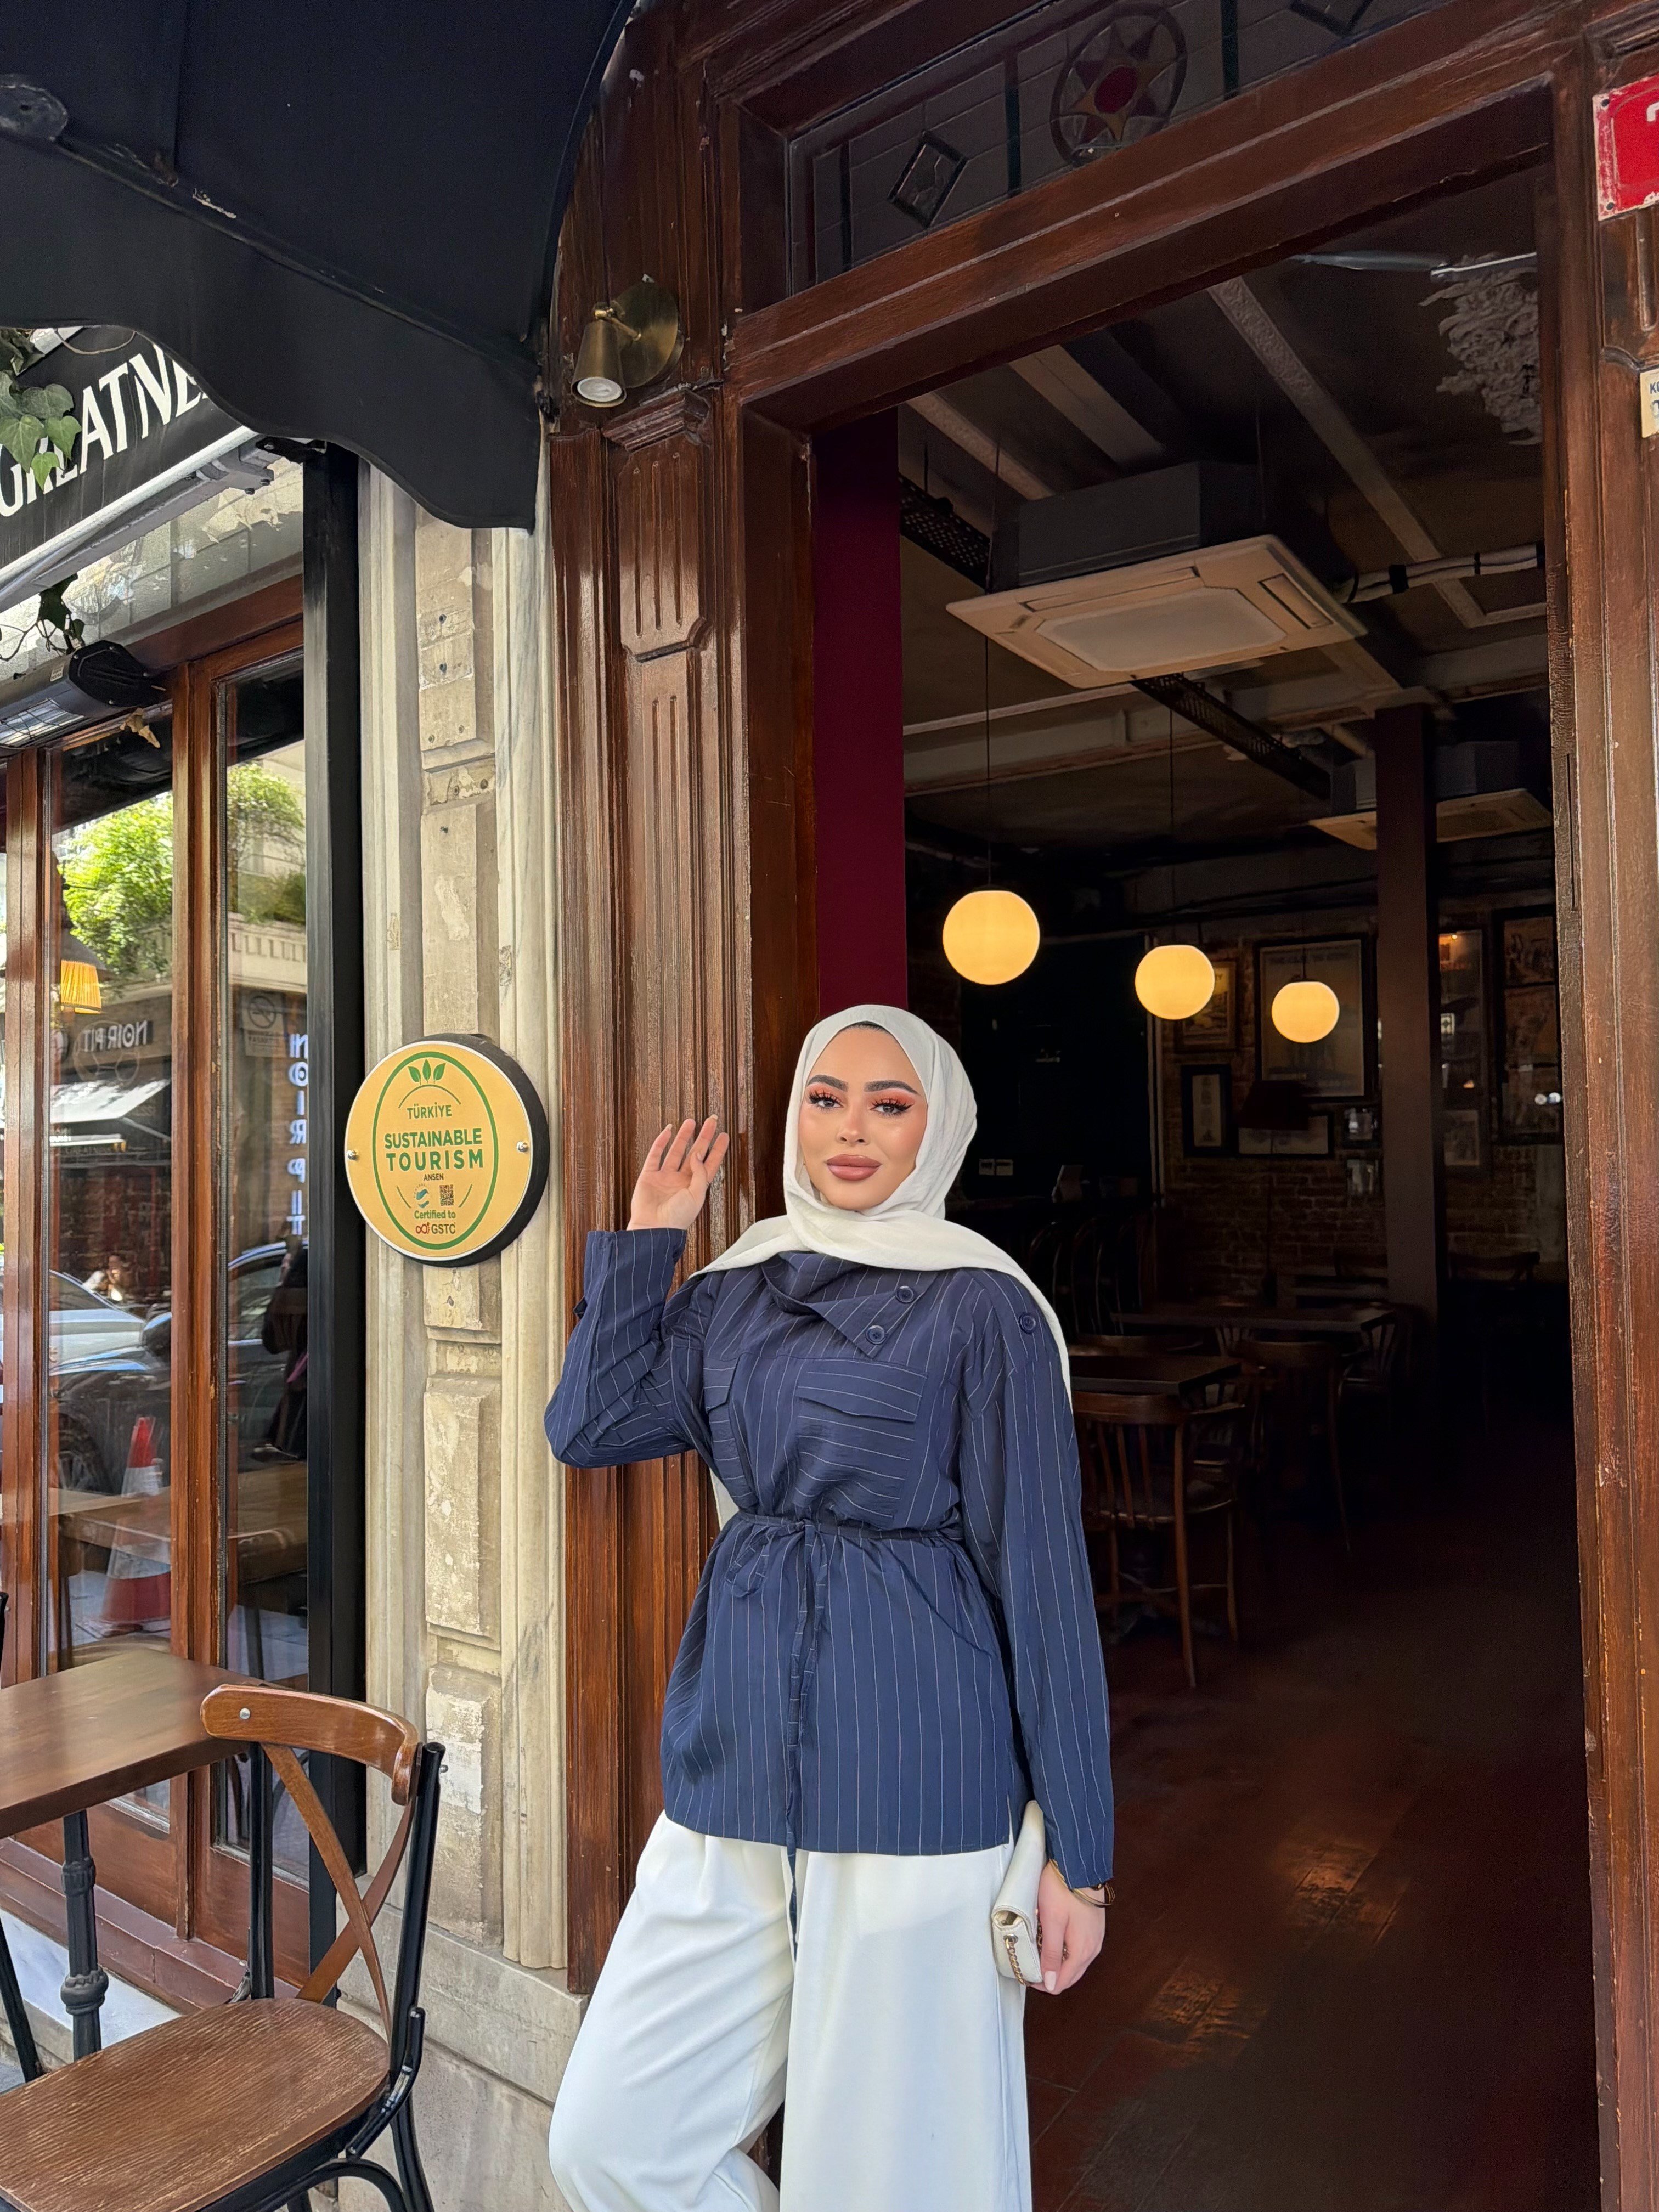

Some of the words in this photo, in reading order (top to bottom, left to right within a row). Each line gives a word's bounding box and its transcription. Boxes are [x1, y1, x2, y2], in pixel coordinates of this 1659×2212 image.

[0, 343, 208, 517] GATNE
[407, 1102, 452, 1120] TÜRKİYE
[384, 1128, 483, 1149] SUSTAINABLE
[386, 1149, 483, 1172] TOURISM
[414, 1209, 446, 1219] Certified
[448, 1210, 456, 1219] to
[431, 1223, 456, 1234] GSTC
